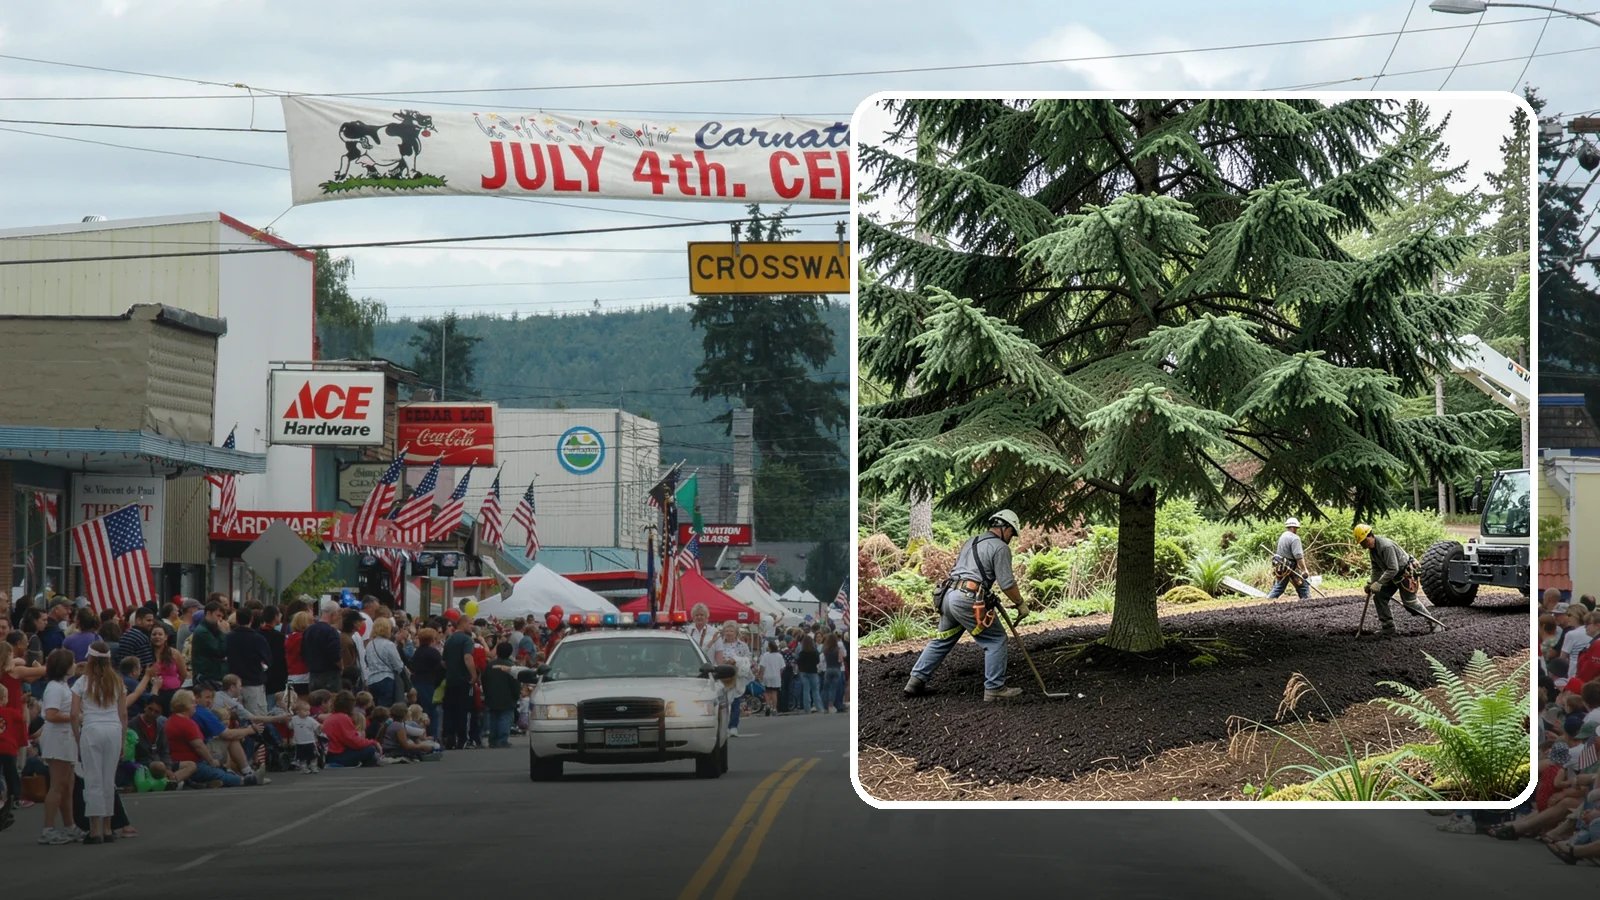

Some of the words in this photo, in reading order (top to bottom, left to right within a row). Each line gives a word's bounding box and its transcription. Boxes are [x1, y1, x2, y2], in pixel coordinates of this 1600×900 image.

[695, 121, 850, 150] Carnat
[481, 141, 604, 192] JULY
[632, 150, 746, 198] 4th.
[696, 254, 850, 280] CROSSWA
[282, 380, 373, 419] ACE
[405, 409, 452, 422] CEDAR
[283, 421, 371, 436] Hardware
[416, 428, 477, 447] Coca-Cola
[83, 484, 92, 494] St.
[95, 485, 124, 494] Vincent
[126, 486, 135, 495] de
[137, 486, 155, 495] Paul
[688, 526, 741, 535] CRNATION
[699, 535, 730, 543] GLASS
